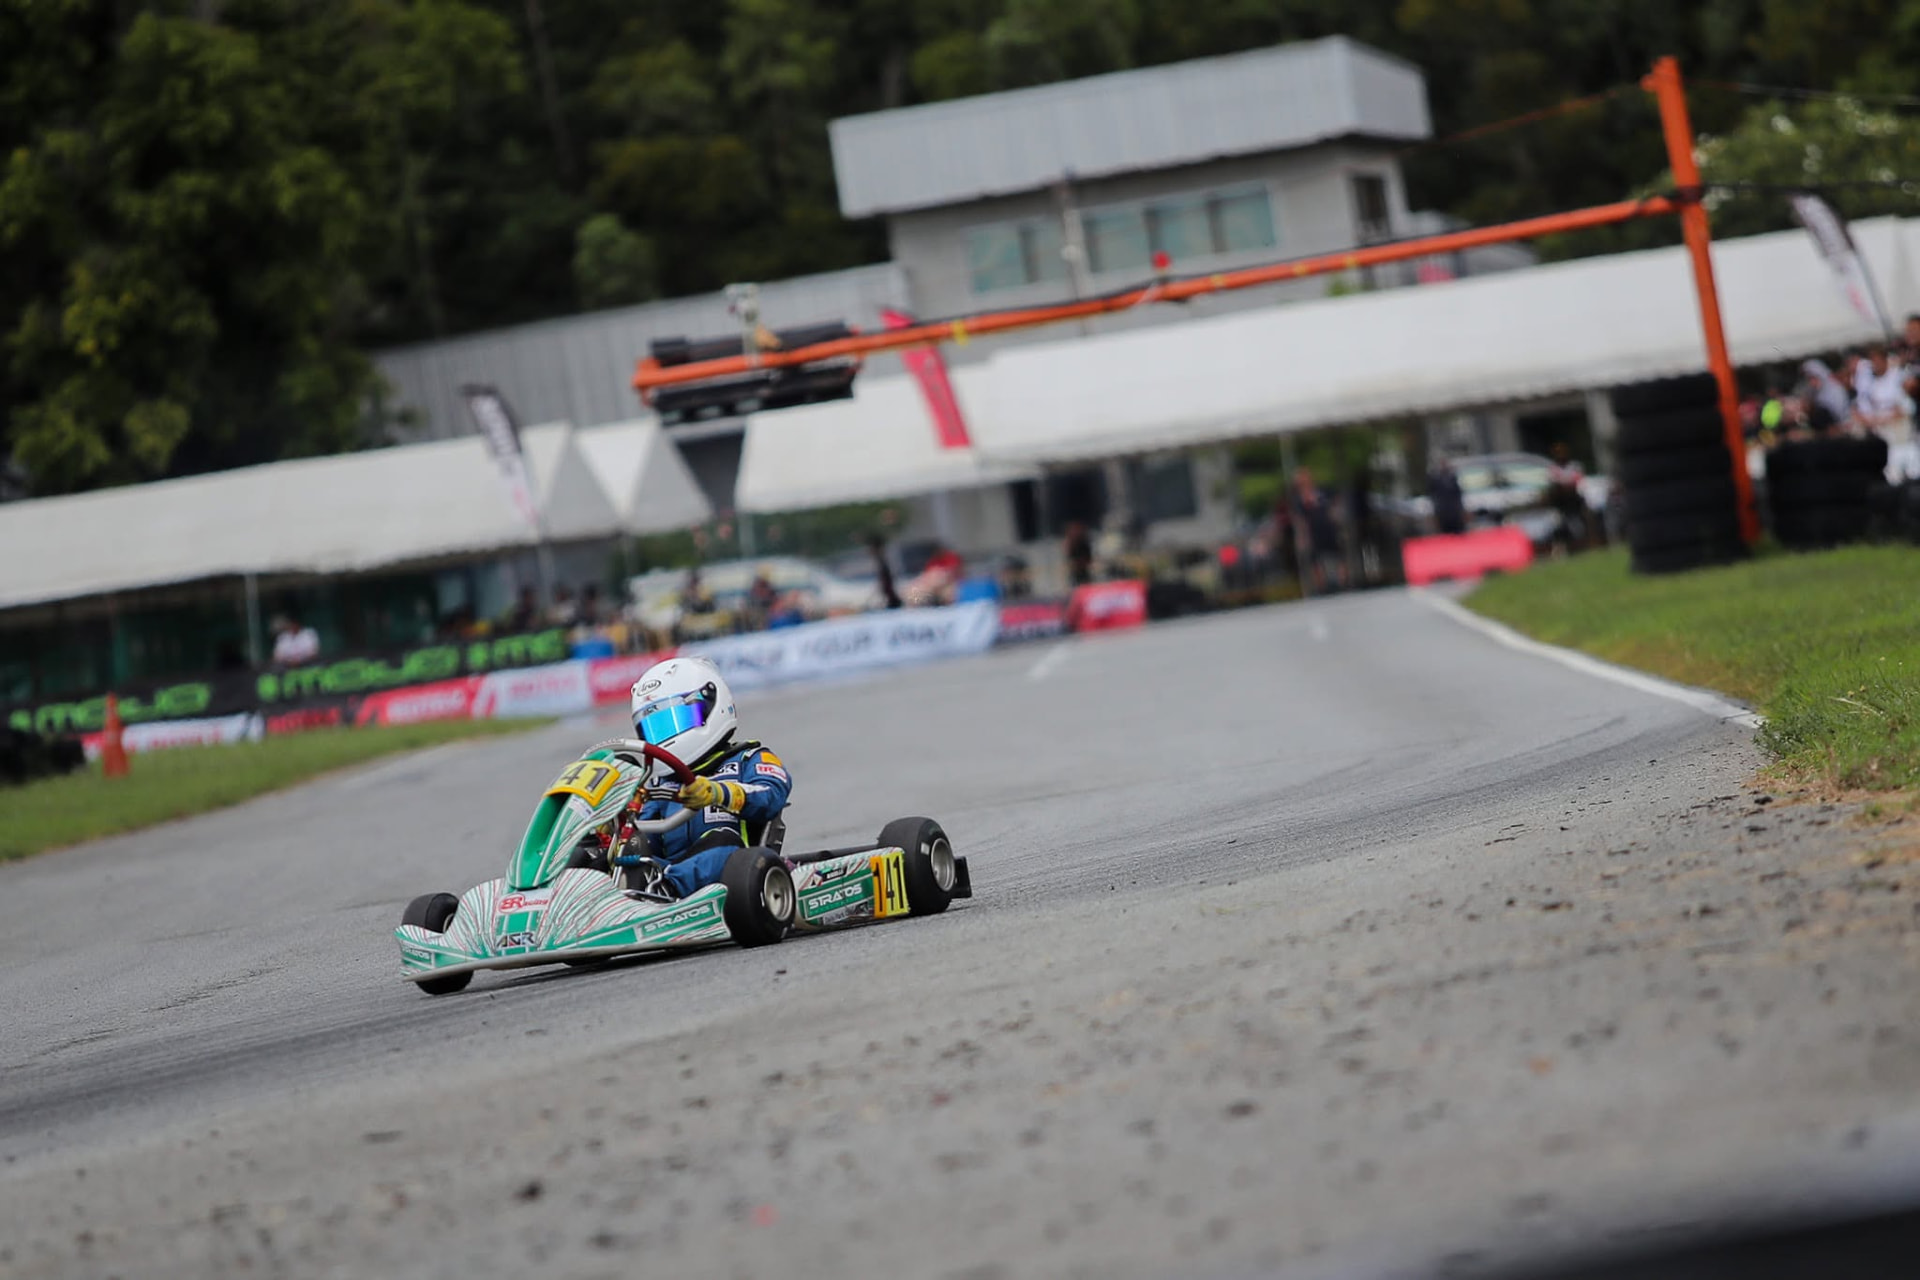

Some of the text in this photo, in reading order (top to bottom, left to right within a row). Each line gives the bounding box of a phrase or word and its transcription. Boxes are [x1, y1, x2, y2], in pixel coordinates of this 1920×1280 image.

[808, 883, 863, 910] STRATOS
[872, 855, 905, 913] 141
[644, 904, 711, 933] STRATOS
